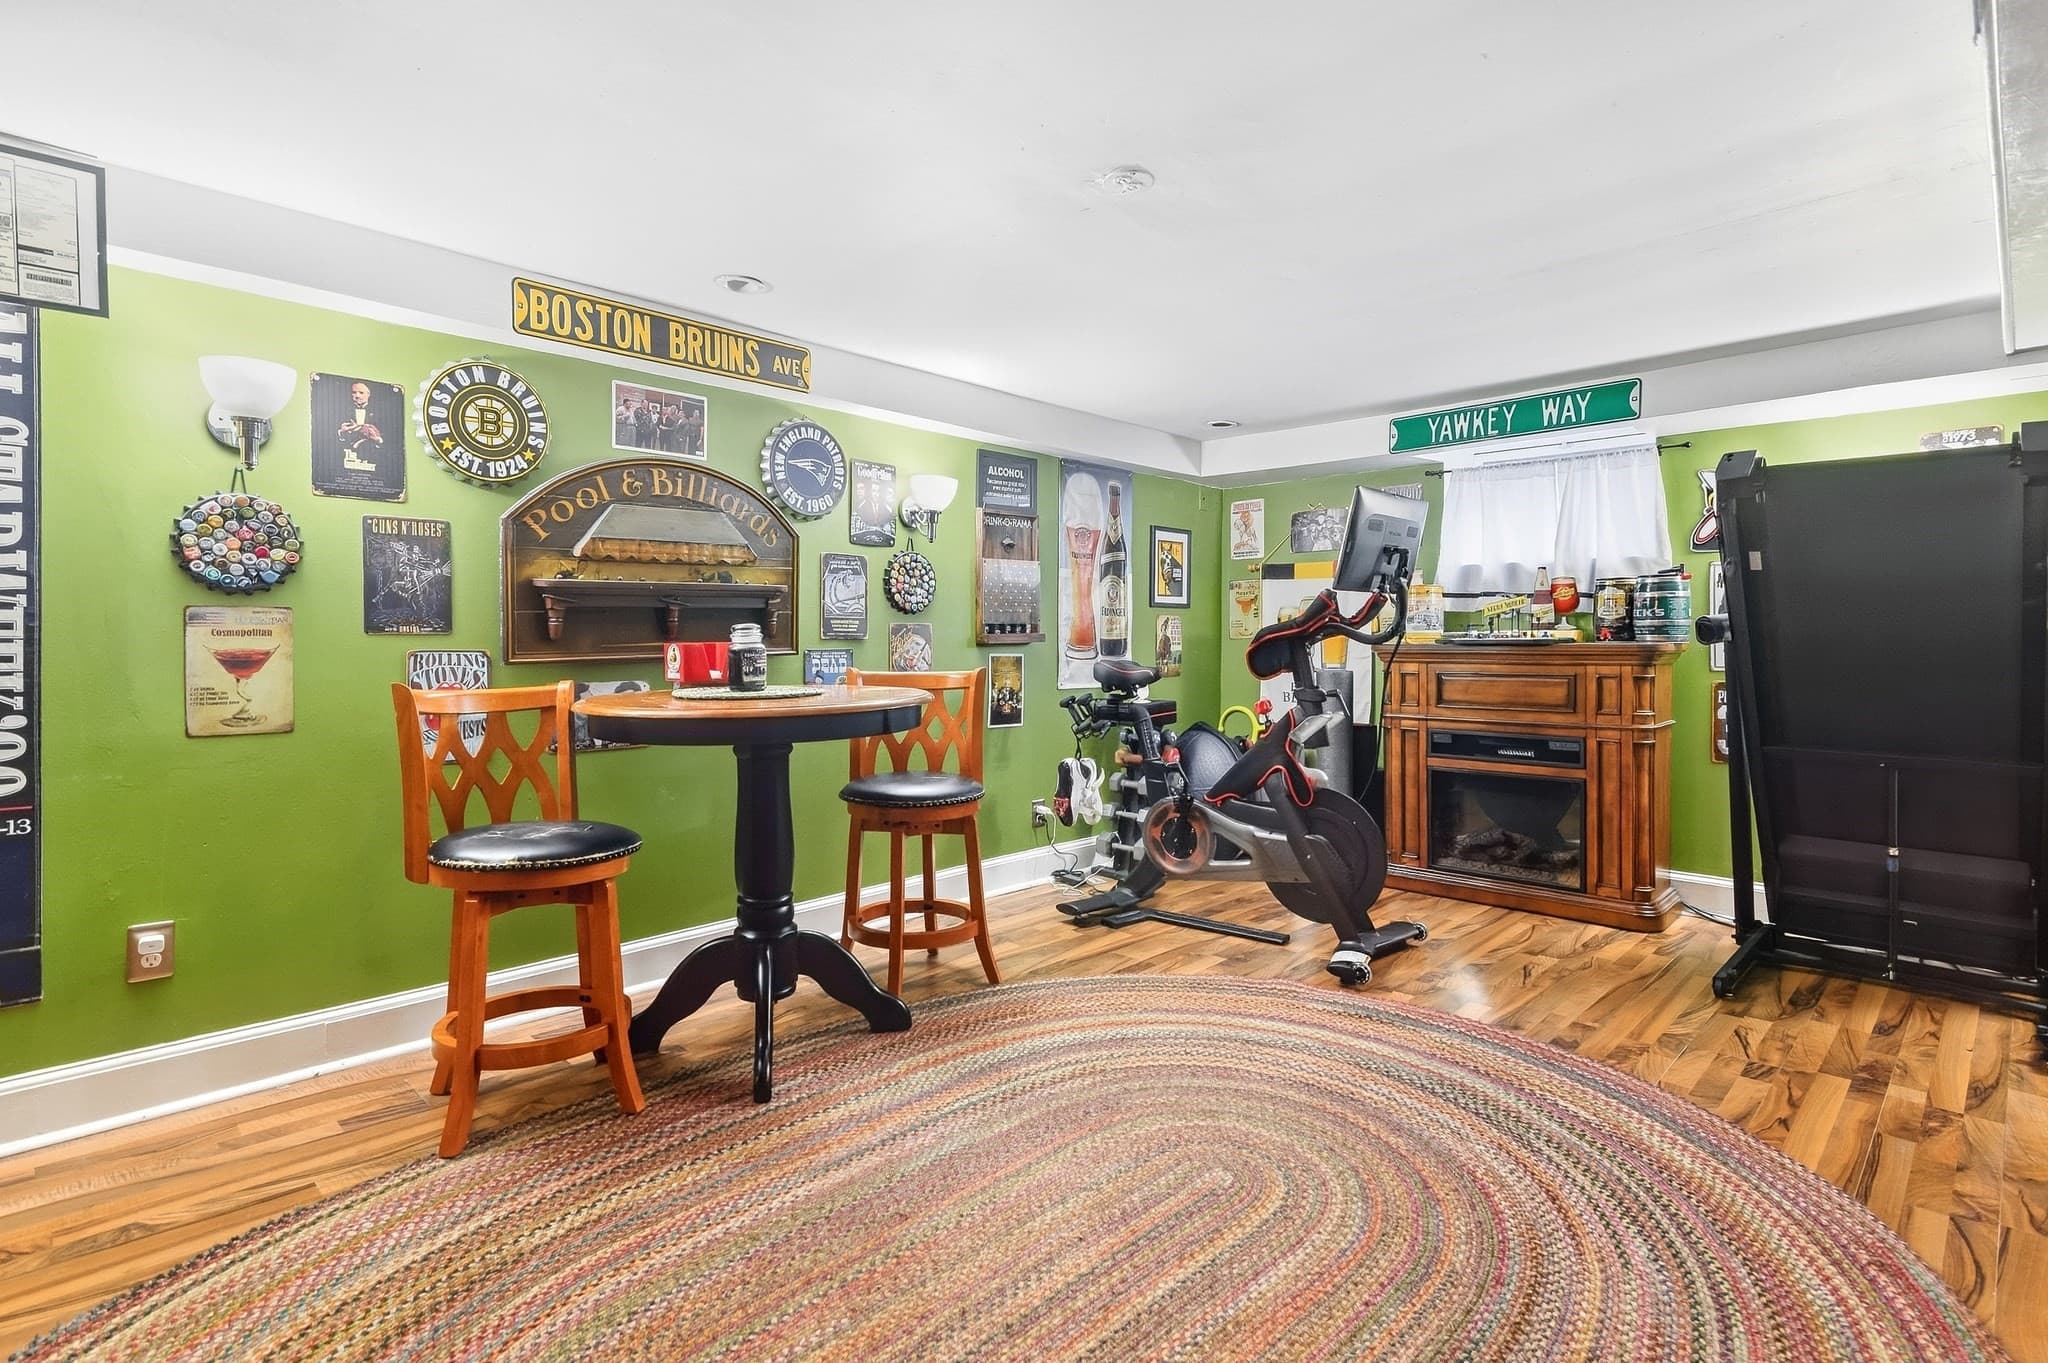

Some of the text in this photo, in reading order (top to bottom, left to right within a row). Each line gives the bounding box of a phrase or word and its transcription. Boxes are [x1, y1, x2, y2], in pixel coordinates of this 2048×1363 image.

[529, 288, 801, 378] BOSTON BRUINS AVE
[429, 365, 547, 452] BOSTON BRUINS
[478, 405, 502, 437] B
[1427, 391, 1592, 443] YAWKEY WAY
[778, 426, 821, 453] ENGLAND
[447, 447, 528, 478] EST. 1924
[773, 448, 786, 482] NEW
[822, 433, 845, 491] PATRIOTS
[987, 465, 1024, 479] ALCOHOL
[522, 467, 780, 548] Pool & Billiards
[783, 486, 834, 513] EST. 1960
[210, 628, 273, 638] Cosmopolitan
[412, 653, 486, 673] ROLLING
